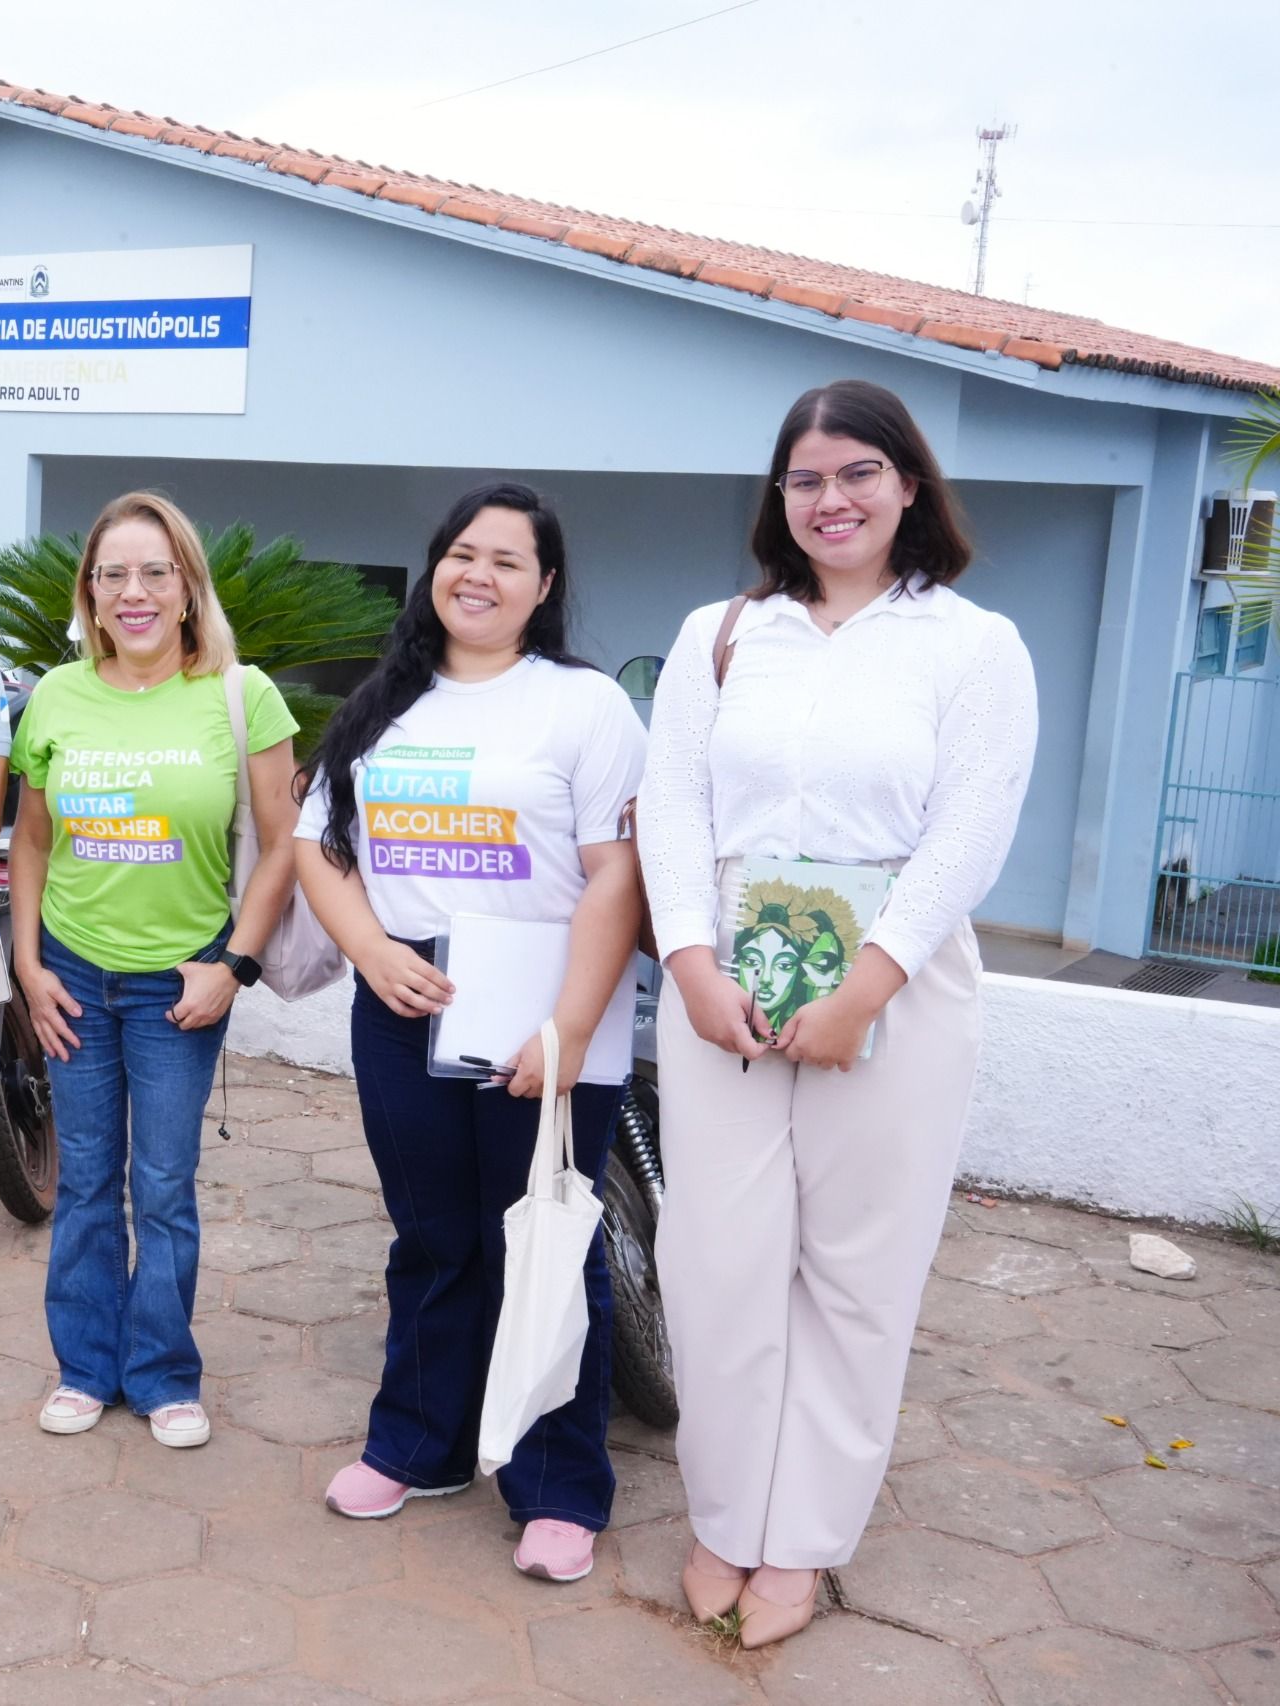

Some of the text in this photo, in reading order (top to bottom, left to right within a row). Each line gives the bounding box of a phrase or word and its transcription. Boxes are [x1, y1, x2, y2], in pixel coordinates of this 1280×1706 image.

[22, 318, 47, 341] DE
[49, 311, 221, 341] AUGUSTINÓPOLIS
[27, 386, 80, 401] ADULTO
[64, 749, 202, 767] DEFENSORIA
[431, 748, 472, 759] Pública
[60, 768, 153, 788] PÚBLICA
[370, 773, 459, 800] LUTAR
[61, 797, 127, 815] LUTAR
[70, 820, 161, 838] ACOLHER
[372, 808, 503, 838] ACOLHER
[75, 838, 176, 862] DEFENDER
[374, 844, 514, 874] DEFENDER
